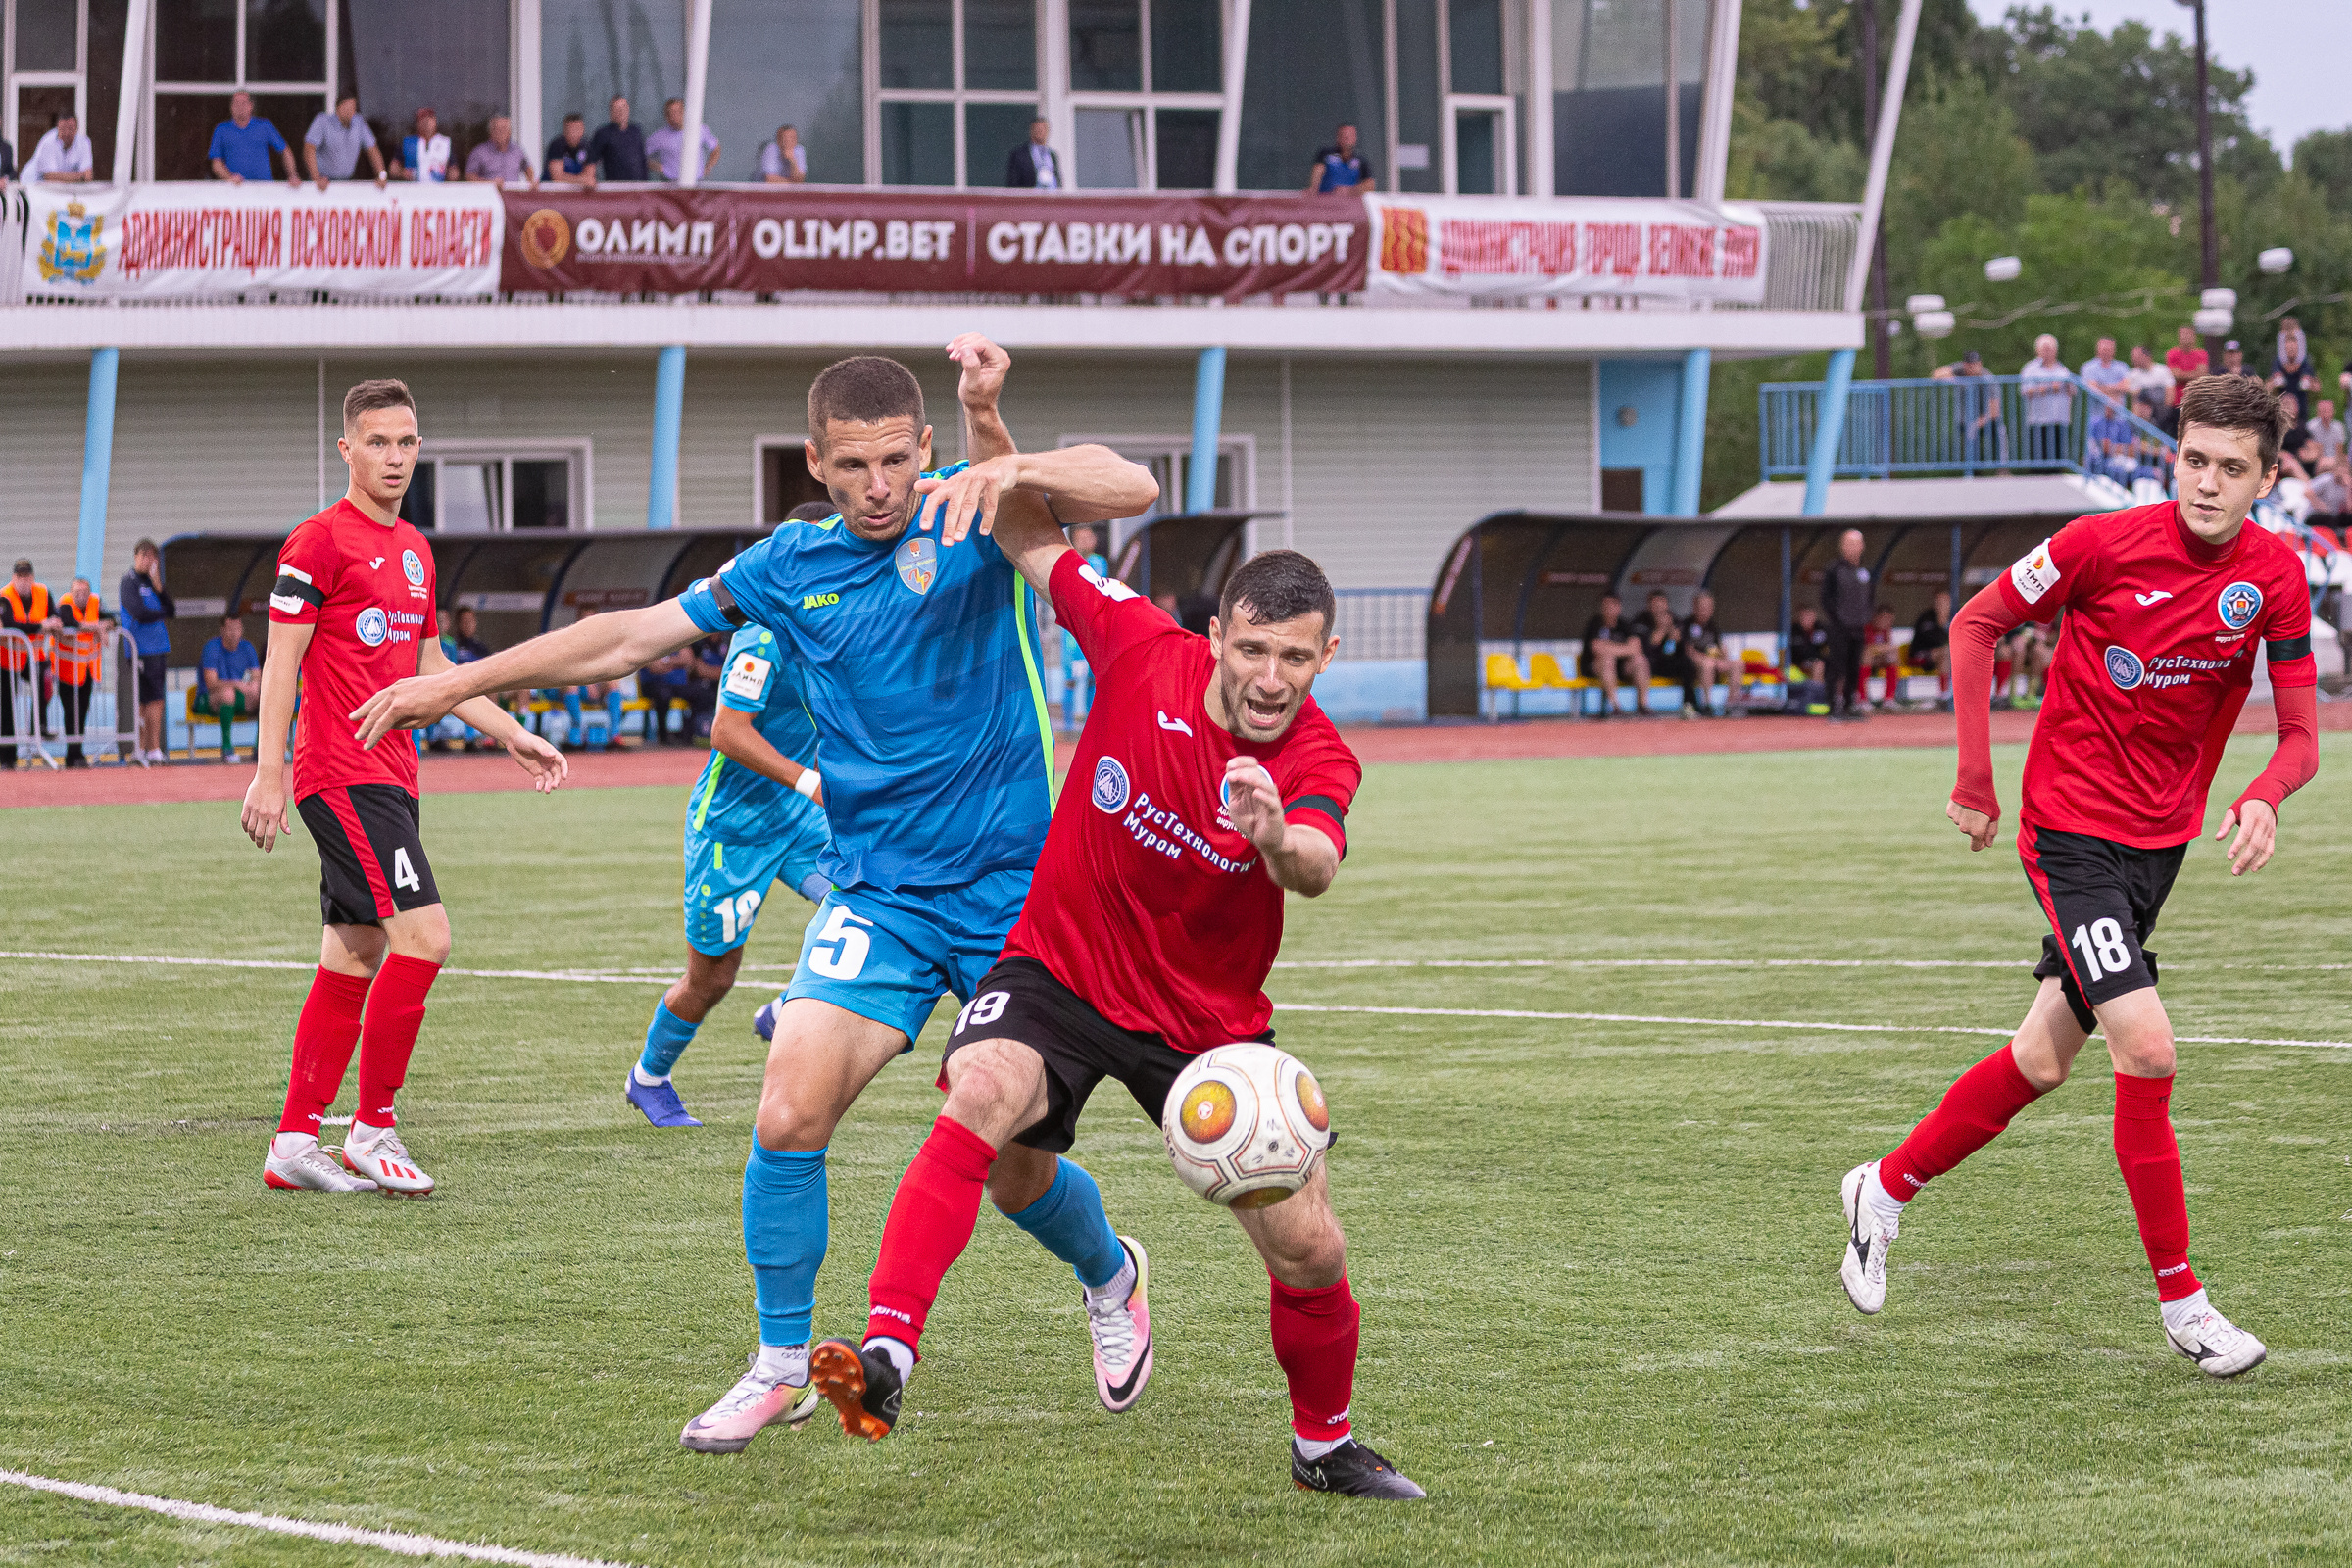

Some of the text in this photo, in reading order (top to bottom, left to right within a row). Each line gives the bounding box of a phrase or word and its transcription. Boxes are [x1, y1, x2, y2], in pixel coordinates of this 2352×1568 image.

[119, 199, 494, 281] АДМИНИСТРАЦИЯ ПСКОВСКОЙ ОБЛАСТИ
[575, 218, 716, 256] ОЛИМП
[752, 218, 956, 261] OLIMP.BET
[986, 220, 1355, 267] СТАВКИ НА СПОРТ
[803, 593, 840, 610] JAKO
[2143, 671, 2191, 689] Муром
[1122, 810, 1183, 860] Муром
[394, 846, 421, 892] 4
[808, 905, 874, 981] 5
[2071, 917, 2132, 982] 18
[955, 991, 1011, 1037] 19
